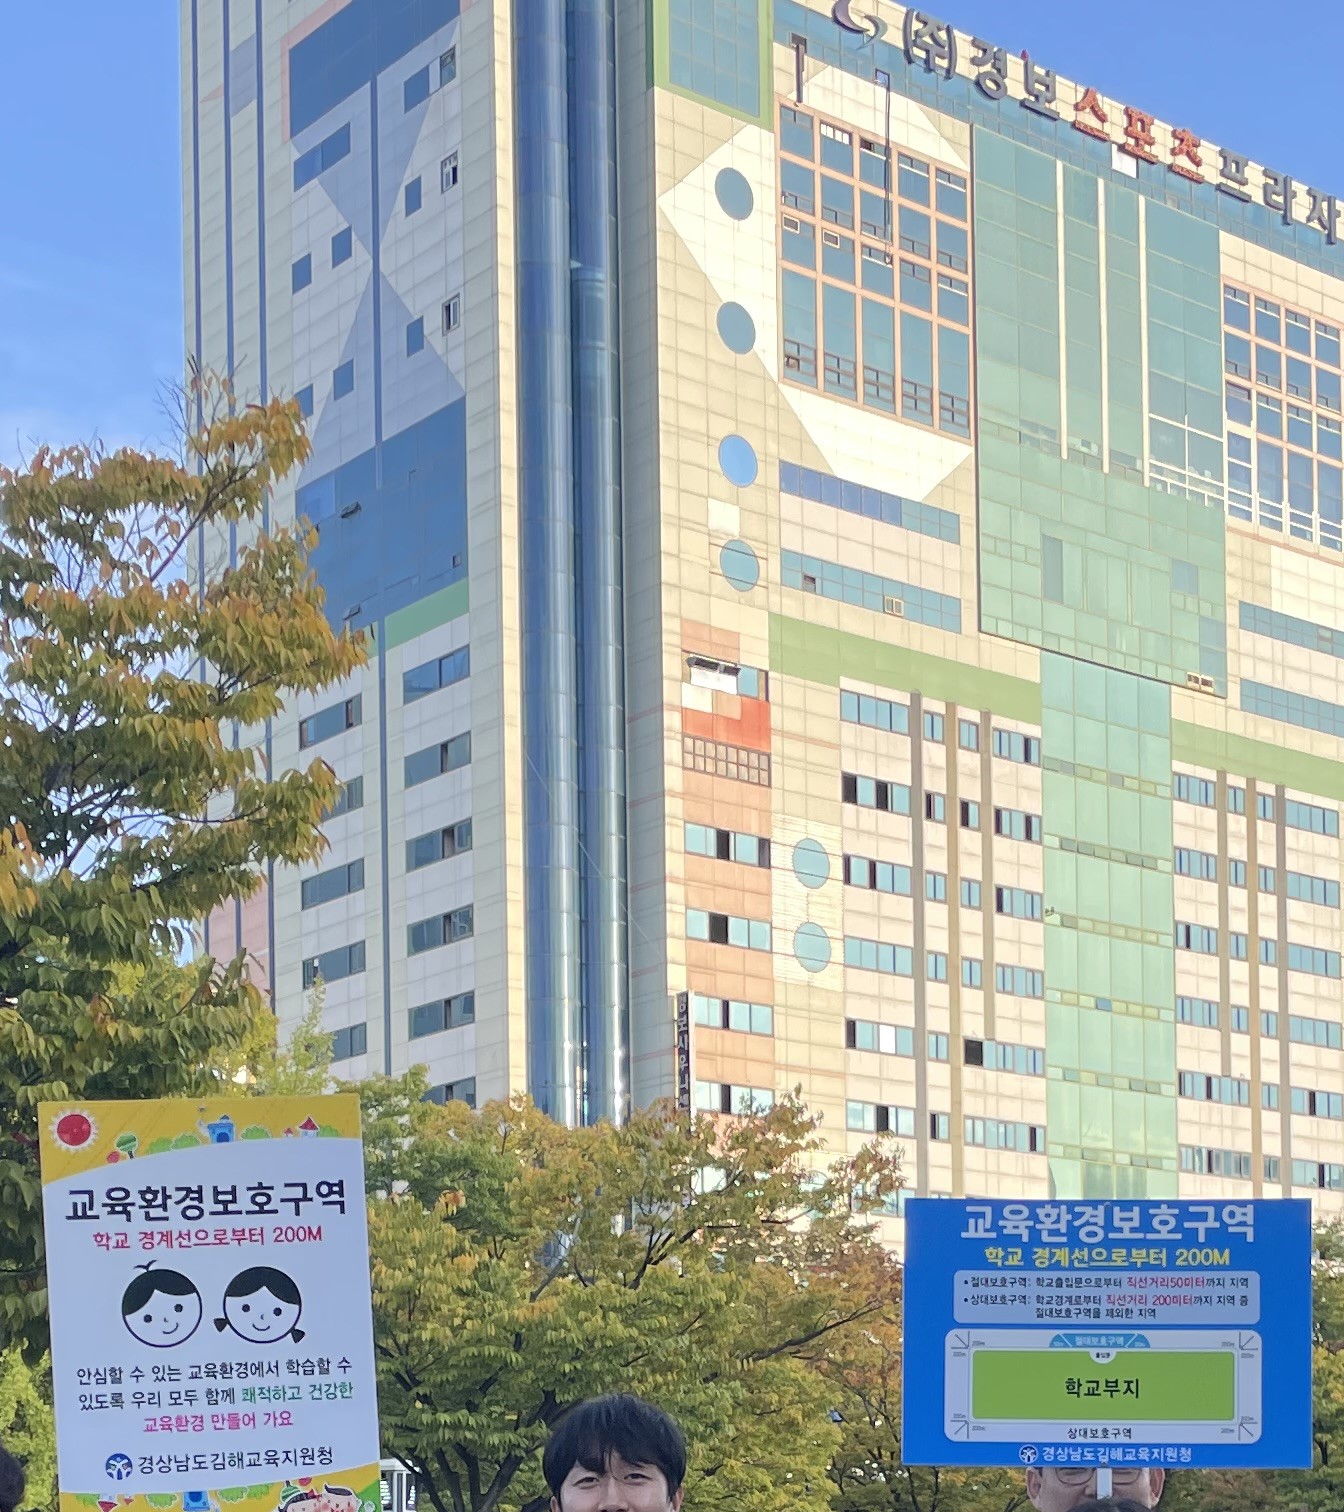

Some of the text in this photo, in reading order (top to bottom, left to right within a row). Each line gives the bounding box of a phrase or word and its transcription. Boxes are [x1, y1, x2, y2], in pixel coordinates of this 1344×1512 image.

[64, 1179, 348, 1223] 교육환경보호구역
[960, 1203, 1256, 1243] 교육환경보호구역
[92, 1225, 323, 1251] 학교 경계선으로부터 200M
[984, 1246, 1231, 1268] 학교 경계선으로부터 200M
[1229, 1277, 1249, 1288] 지역
[1105, 1294, 1148, 1307] 직선거리
[1216, 1294, 1236, 1306] 지역
[1104, 1307, 1134, 1319] 제외한
[1137, 1308, 1157, 1319] 지역
[76, 1356, 353, 1387] 안심할 수 있는 교육환경에서 학습할 수
[78, 1381, 354, 1412] 있도록 우리 모두 함께 쾌적하고 건강한
[1064, 1377, 1139, 1399] 학교부지
[142, 1409, 294, 1433] 교육환경 만들어 가요
[1067, 1427, 1132, 1440] 상대보호구역
[137, 1446, 334, 1475] 경상남도김해교육지원청
[1041, 1445, 1193, 1464] 경상남도김해교육지원청
